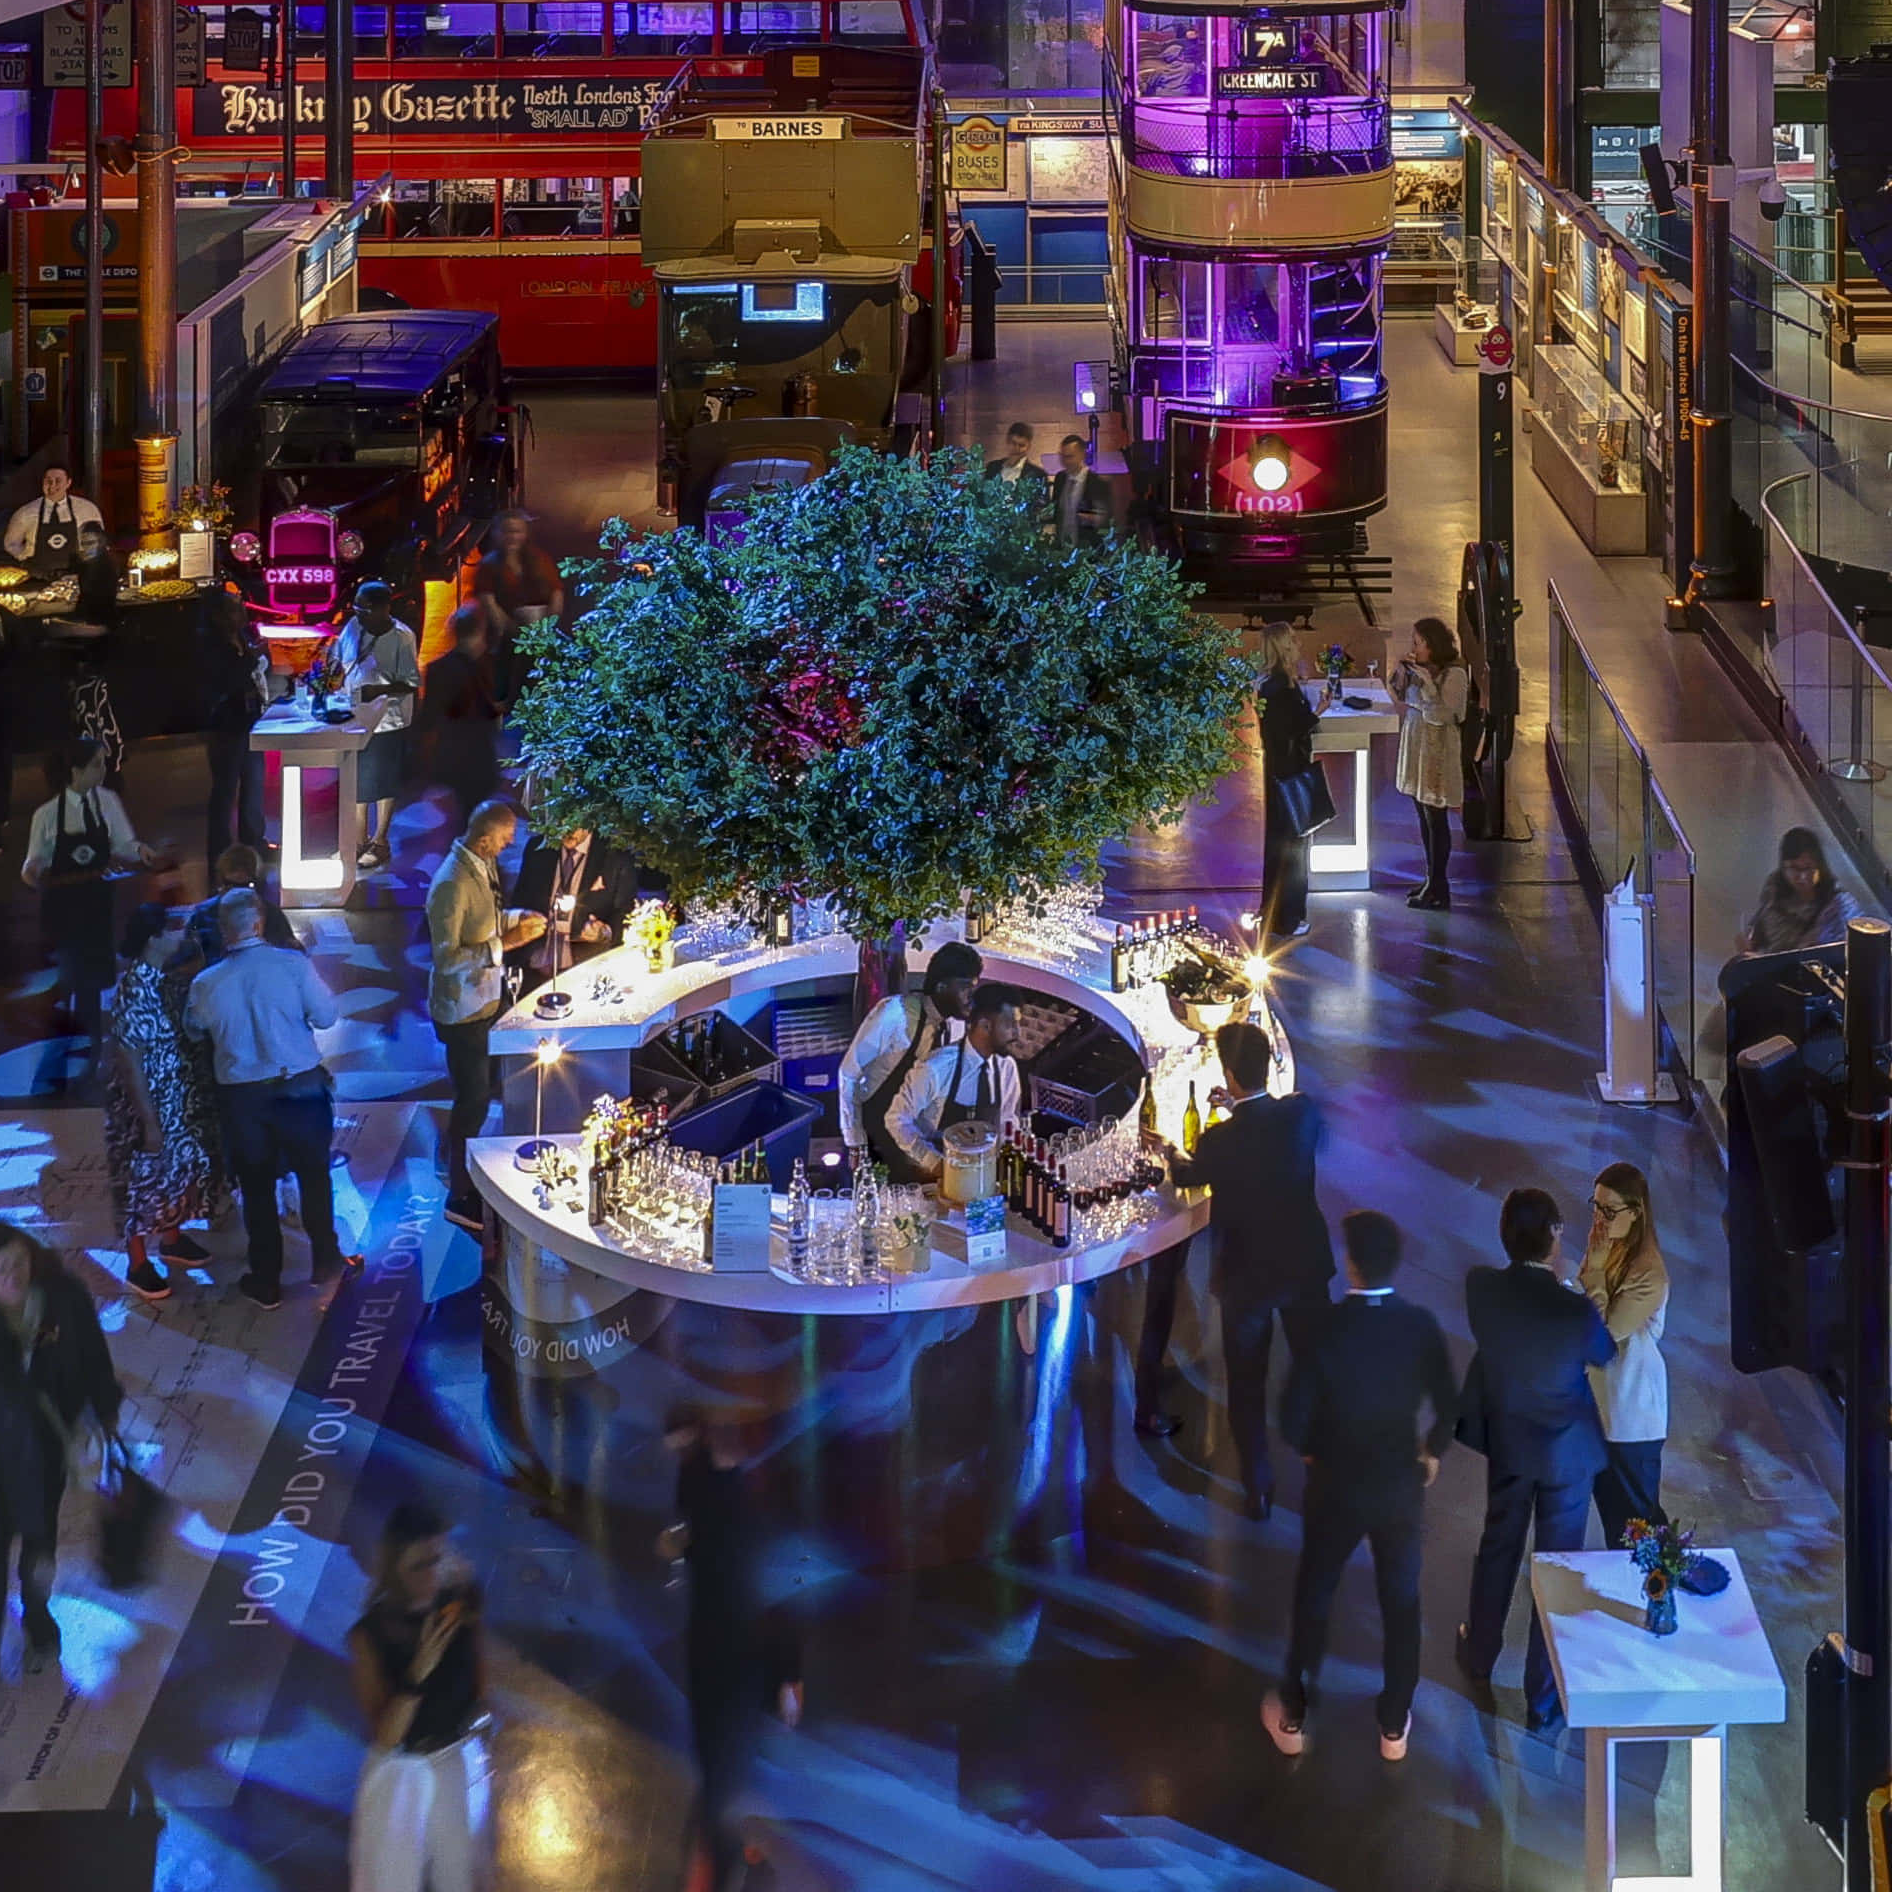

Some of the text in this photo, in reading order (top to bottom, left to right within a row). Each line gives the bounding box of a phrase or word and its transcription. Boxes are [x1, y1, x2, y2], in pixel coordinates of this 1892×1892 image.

[57, 25, 118, 35] TO TMS
[227, 29, 257, 51] STOP
[1255, 33, 1286, 57] 7A
[50, 48, 124, 57] BLACKARS
[61, 60, 113, 69] STATN
[221, 84, 371, 133] Hakny
[382, 83, 516, 123] Gazette
[523, 84, 568, 105] North
[574, 83, 642, 105] London's
[752, 121, 823, 137] BARNES
[1031, 120, 1084, 130] KINGSWAY
[958, 156, 998, 169] BUSES
[113, 267, 138, 277] DEPO
[521, 280, 594, 297] LONDON
[1678, 316, 1688, 332] On
[1678, 335, 1688, 354] the
[1678, 357, 1689, 395] surface
[1496, 381, 1506, 400] 9
[266, 569, 335, 584] CXX 598
[229, 1194, 440, 1626] HOW DID YOU TRAVEL TODAY?
